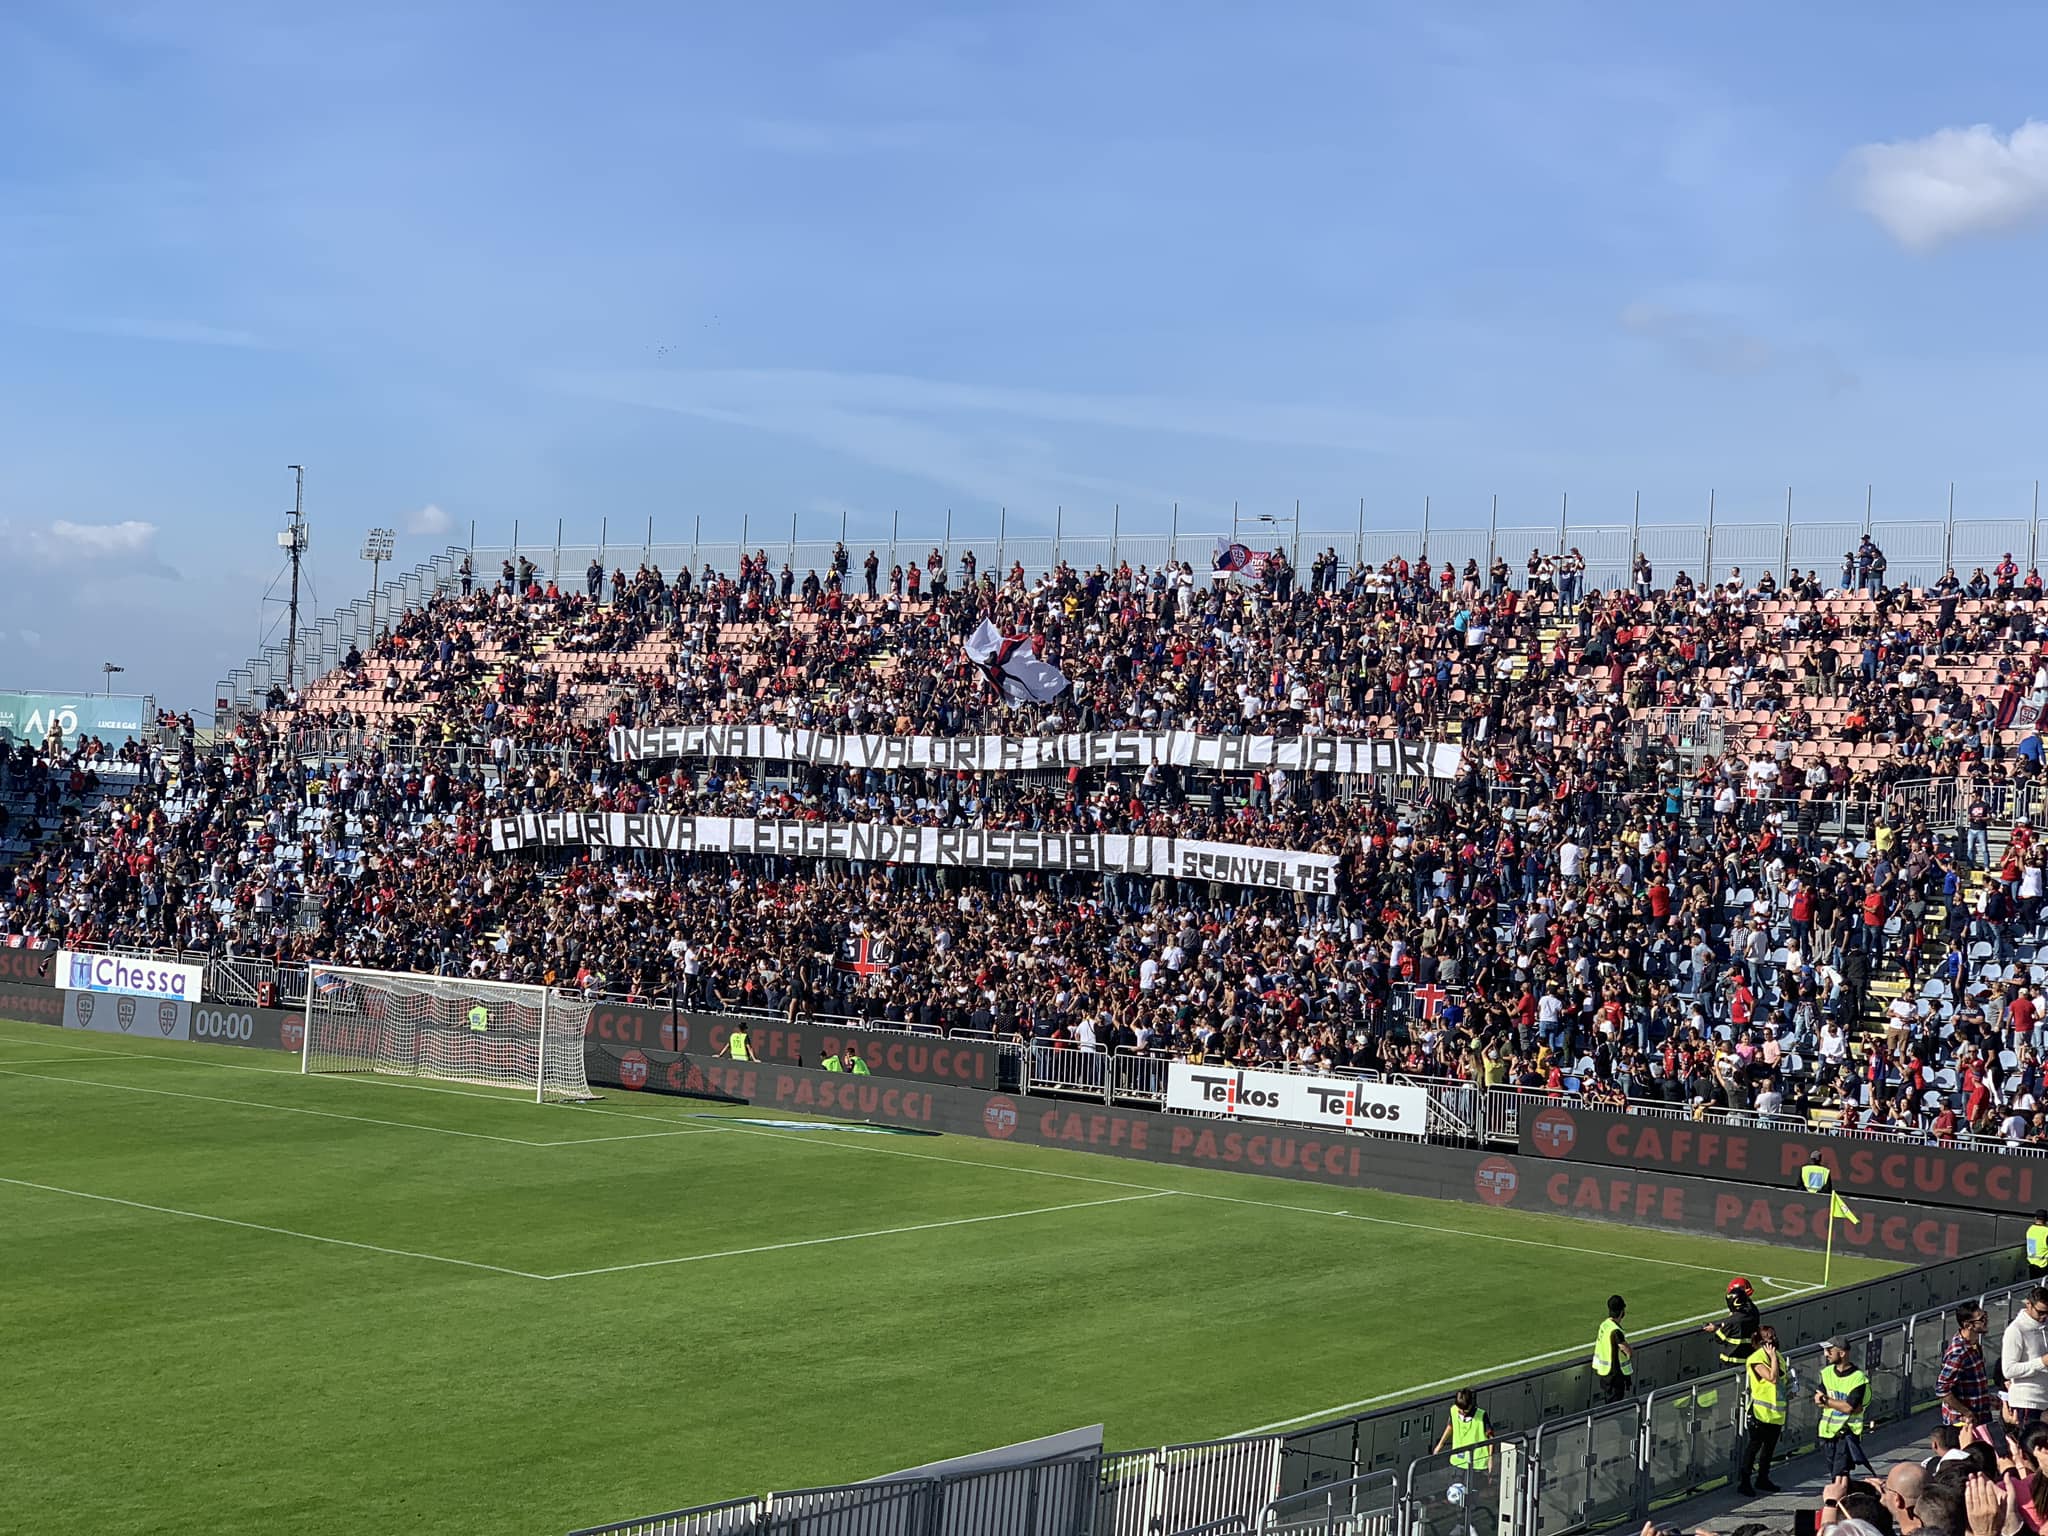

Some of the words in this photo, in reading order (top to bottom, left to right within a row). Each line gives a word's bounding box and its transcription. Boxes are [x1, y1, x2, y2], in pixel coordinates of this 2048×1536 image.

[616, 727, 748, 761] INSEGNA
[759, 727, 765, 757] I
[776, 726, 845, 765] TUOI
[860, 735, 985, 769] VALORI
[1000, 736, 1023, 769] A
[1036, 730, 1176, 768] QUESTI
[1190, 735, 1434, 776] CALCIATORI
[501, 813, 611, 849] AUGURI
[624, 813, 720, 851] RIVA...
[729, 817, 921, 863] LEGGENDA
[1183, 851, 1329, 893] SCONVOLTS
[96, 958, 185, 994] Chessa
[196, 1010, 253, 1040] 00:00
[667, 1061, 756, 1098] CAFFE
[776, 1076, 933, 1121] PASCUCCI
[1191, 1071, 1279, 1112] Teikos
[1307, 1083, 1400, 1125] Teikos
[1040, 1110, 1148, 1150] CAFFE
[1171, 1126, 1360, 1177] PASCUCCI
[1606, 1124, 1748, 1170] CAFFE
[1781, 1143, 2033, 1203] PASCUCCI
[1547, 1172, 1684, 1221] CAFFE
[1715, 1195, 1960, 1257] PASCUCCI
